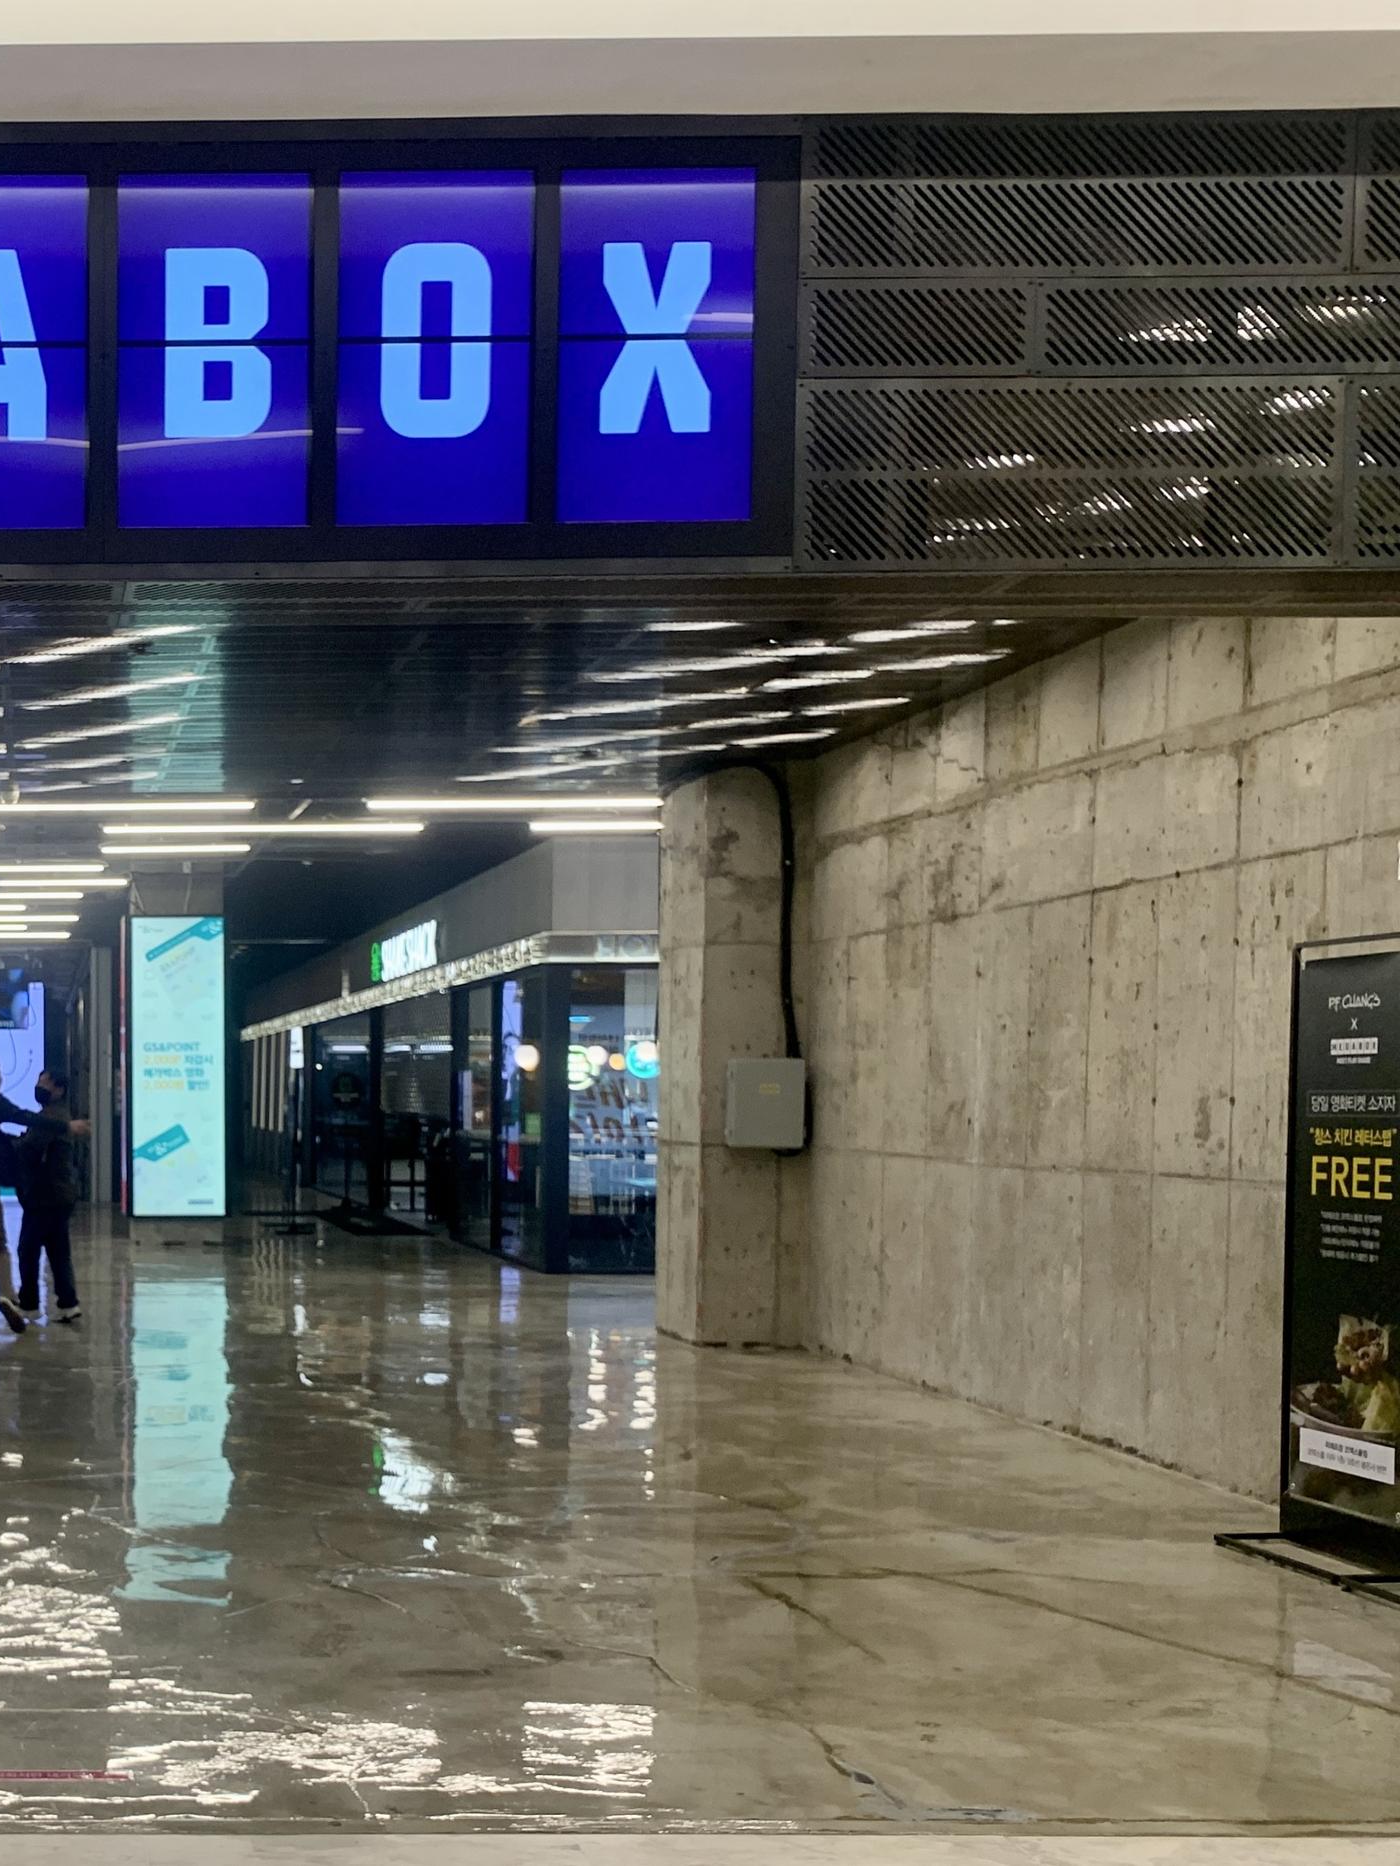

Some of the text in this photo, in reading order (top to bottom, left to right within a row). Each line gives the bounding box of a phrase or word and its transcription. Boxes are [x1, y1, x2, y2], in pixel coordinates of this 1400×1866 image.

[1311, 1095, 1396, 1112] 당일 영화티켓 소지자
[1311, 1156, 1393, 1200] FREE
